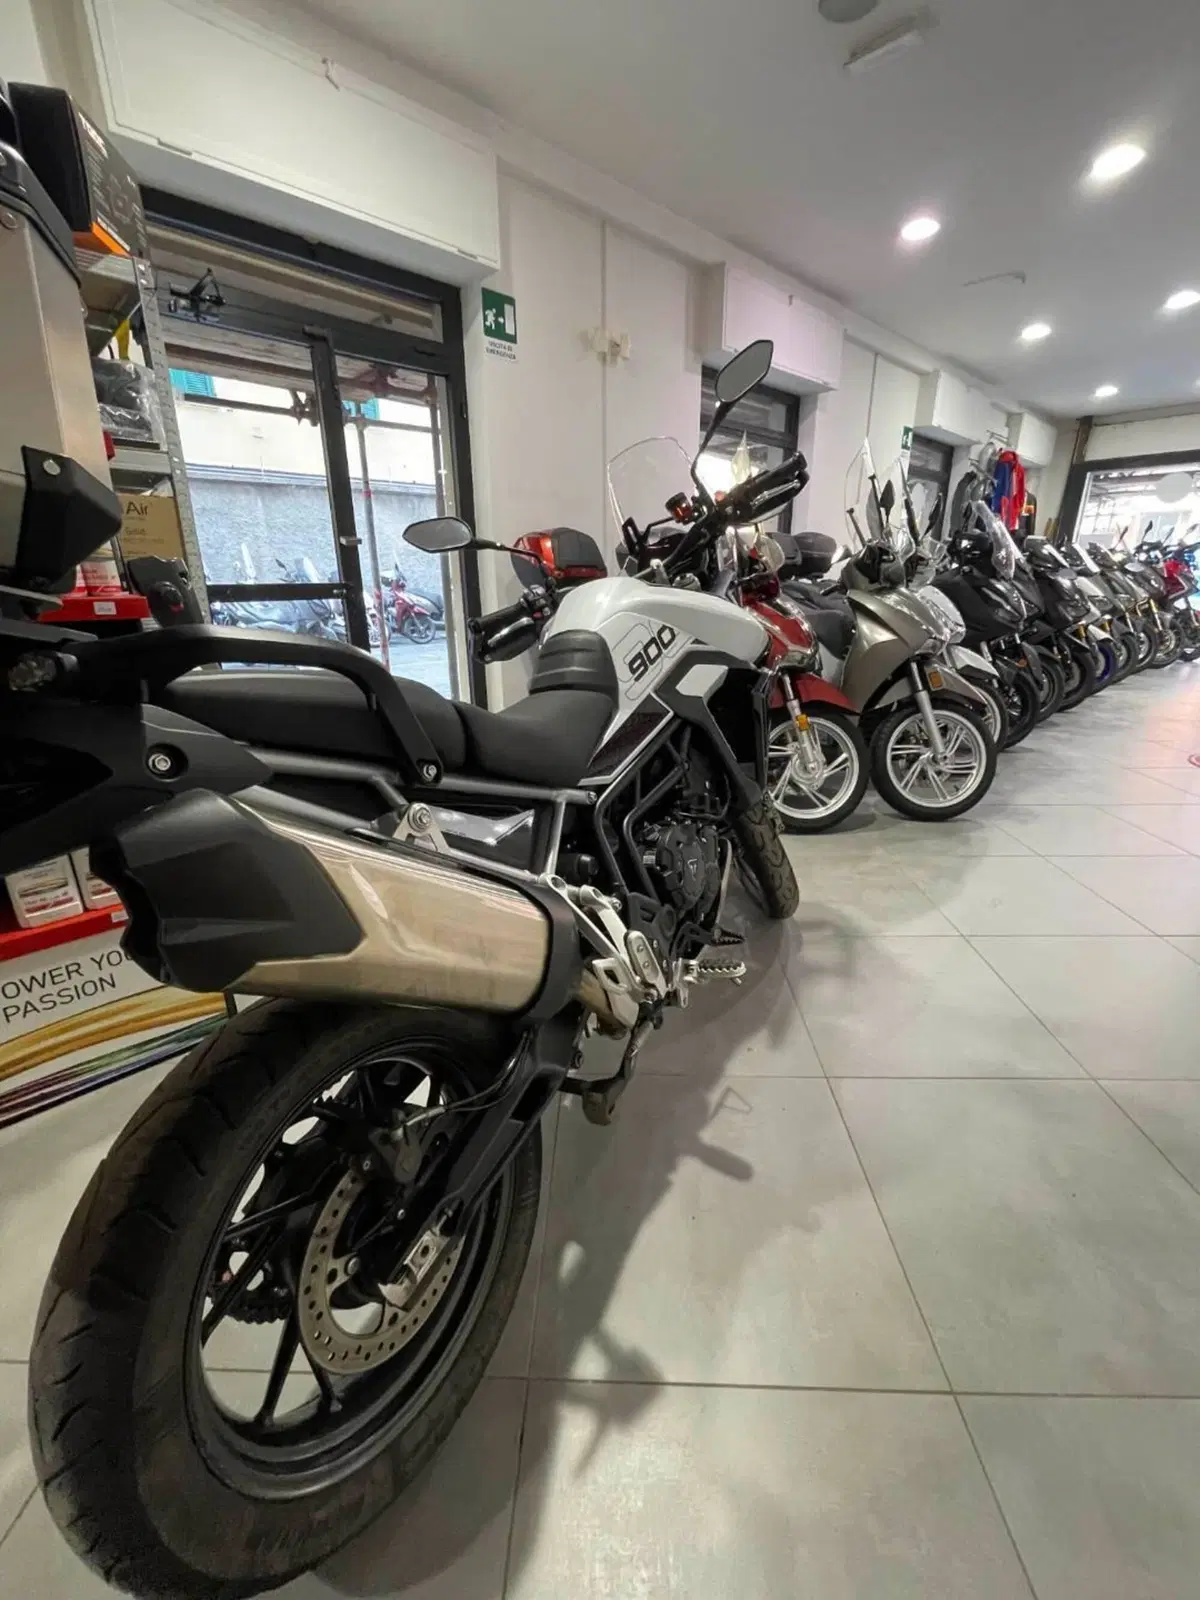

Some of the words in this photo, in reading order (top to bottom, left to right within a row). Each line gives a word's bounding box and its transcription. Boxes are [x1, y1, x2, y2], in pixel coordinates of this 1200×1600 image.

[628, 624, 676, 682] 900
[1, 962, 84, 999] OWER
[2, 973, 116, 1023] PASSION
